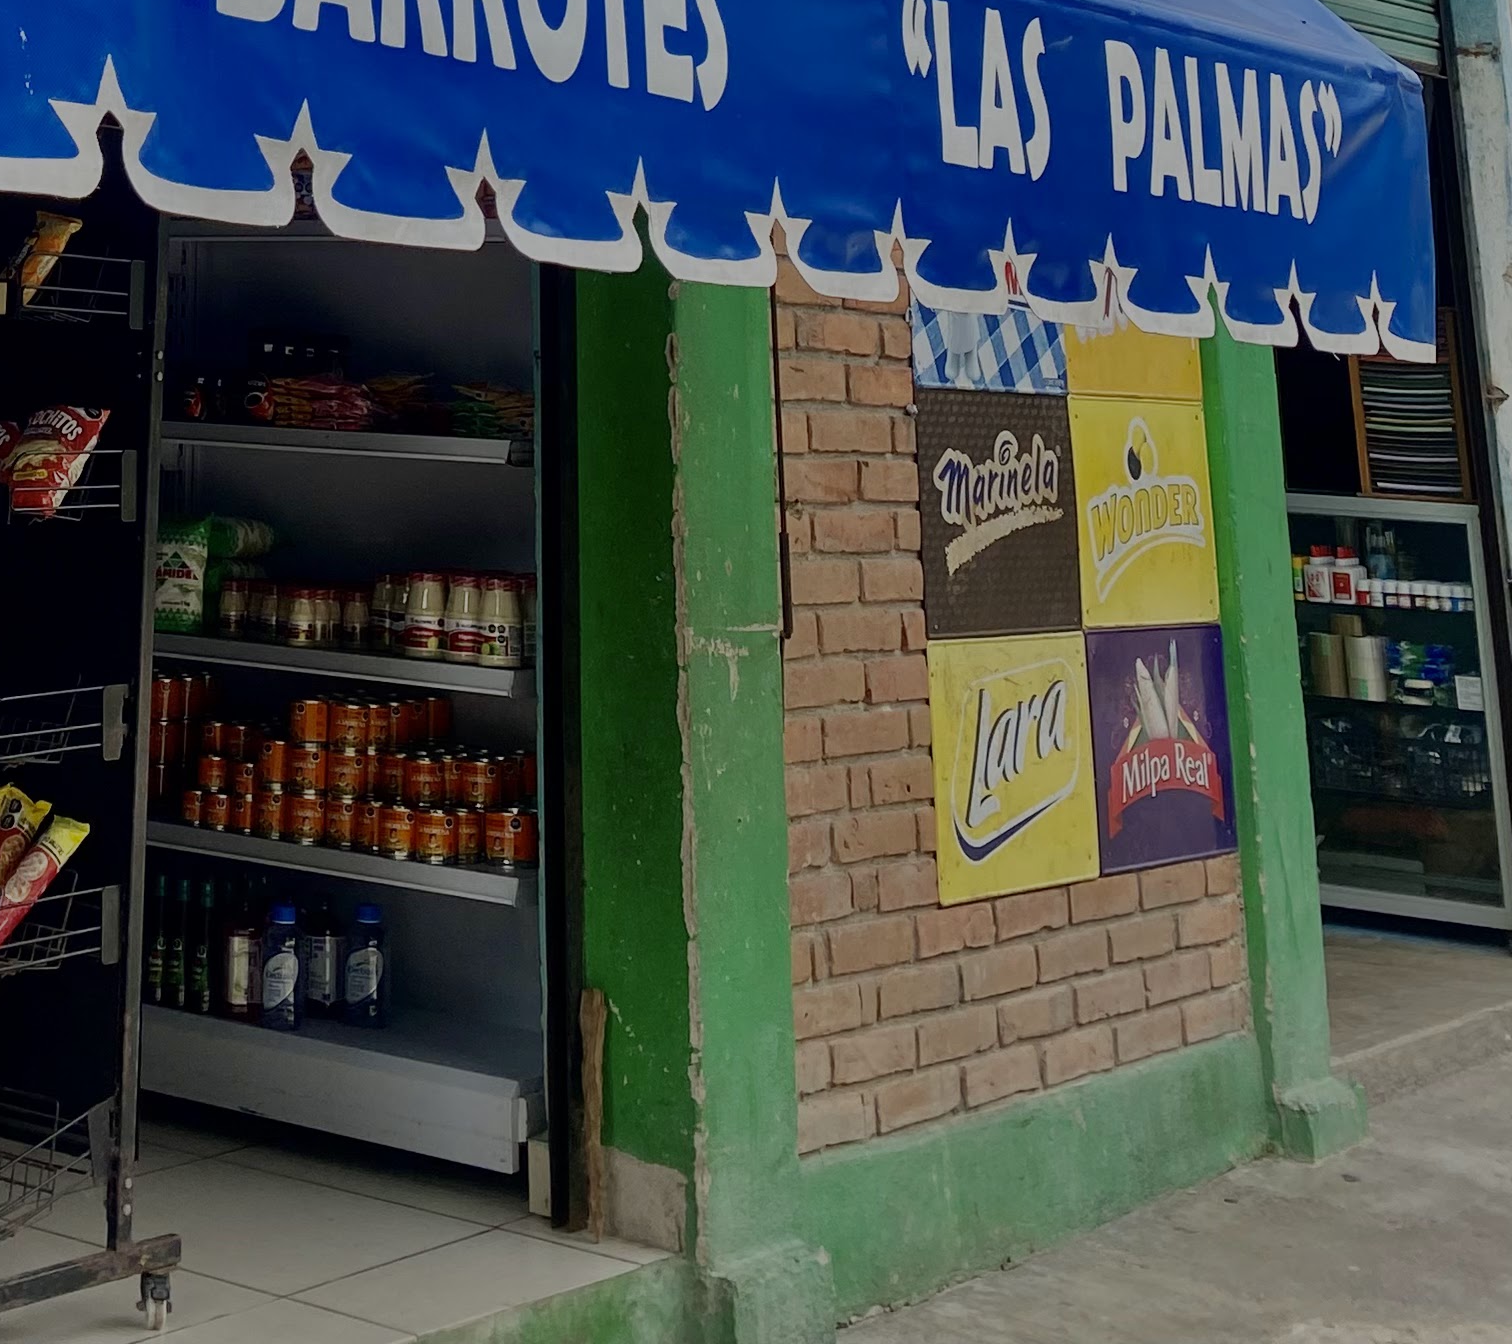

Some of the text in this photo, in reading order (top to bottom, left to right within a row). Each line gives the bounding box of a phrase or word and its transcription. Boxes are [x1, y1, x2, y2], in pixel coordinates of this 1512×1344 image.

[936, 430, 1061, 525] Marinela
[1090, 480, 1201, 561] WONDER
[966, 679, 1066, 828] Lara
[1122, 742, 1210, 804] Milpa Real
